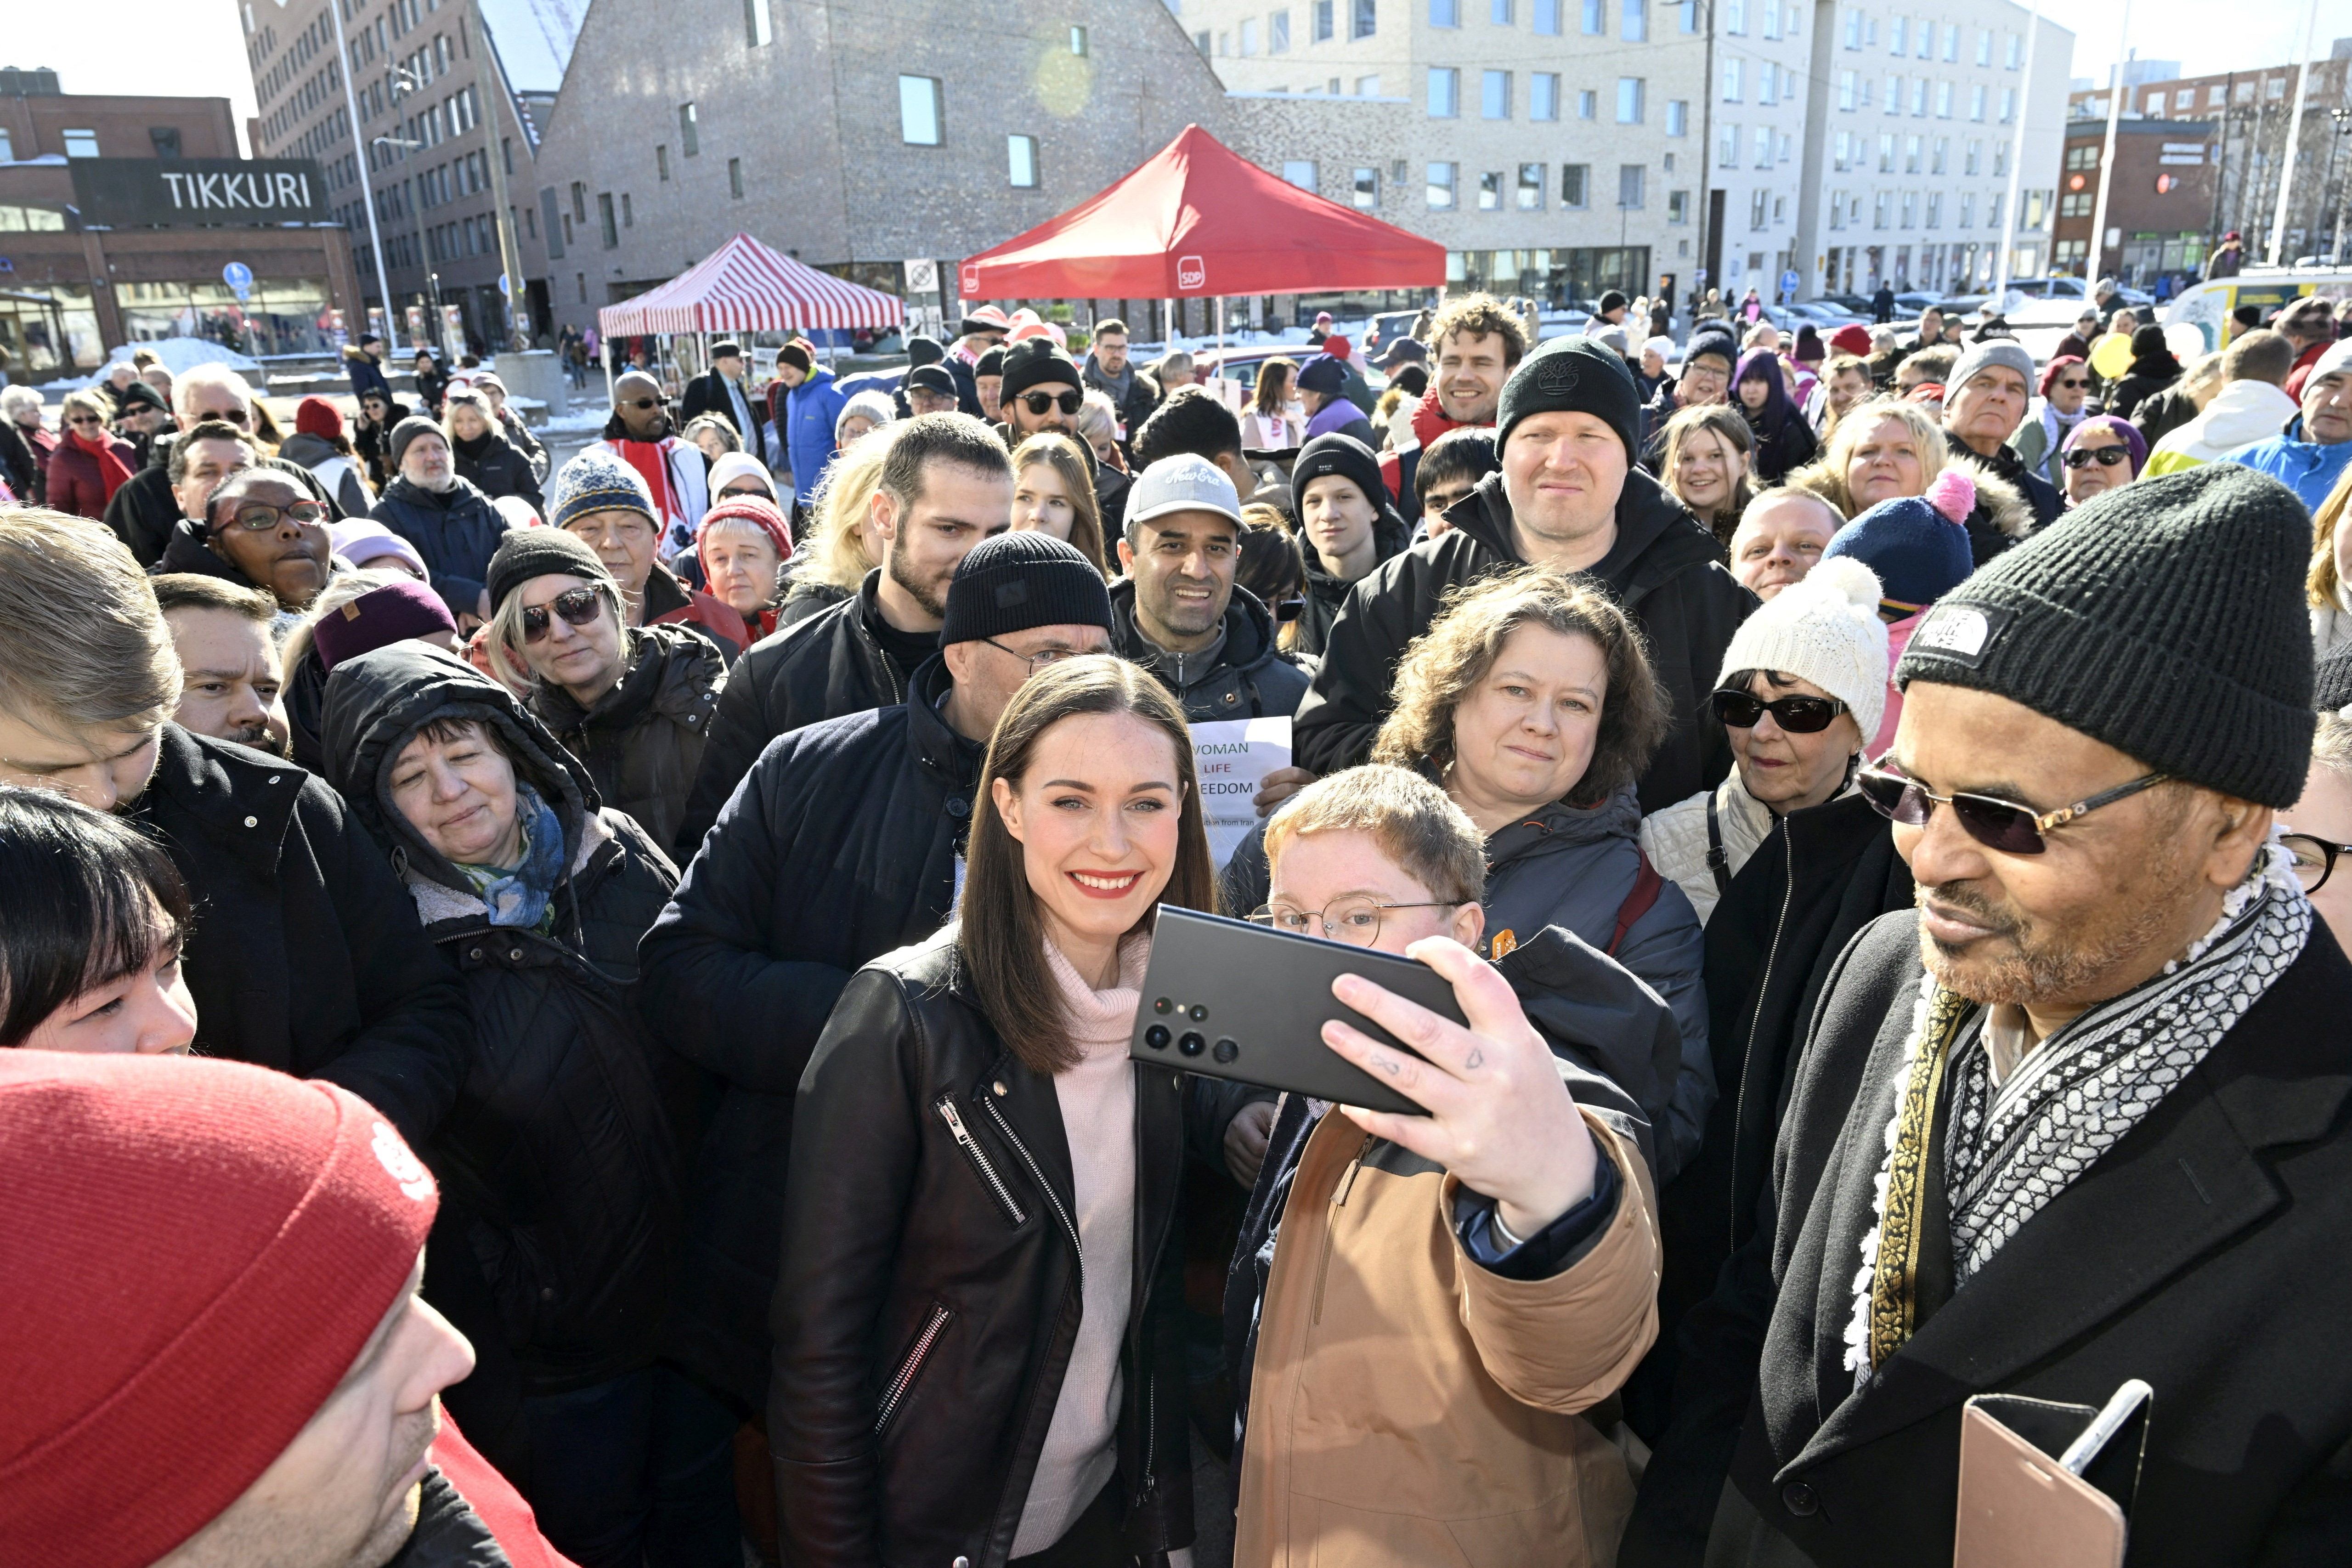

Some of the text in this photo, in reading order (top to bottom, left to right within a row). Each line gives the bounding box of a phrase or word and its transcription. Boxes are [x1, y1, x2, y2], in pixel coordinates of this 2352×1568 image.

[161, 173, 311, 209] TIKKURI
[1182, 271, 1202, 284] SDP
[1984, 328, 2010, 337] adid
[1165, 467, 1220, 486] New Era
[1204, 764, 1231, 773] LIFE
[1201, 782, 1252, 794] EEDOM
